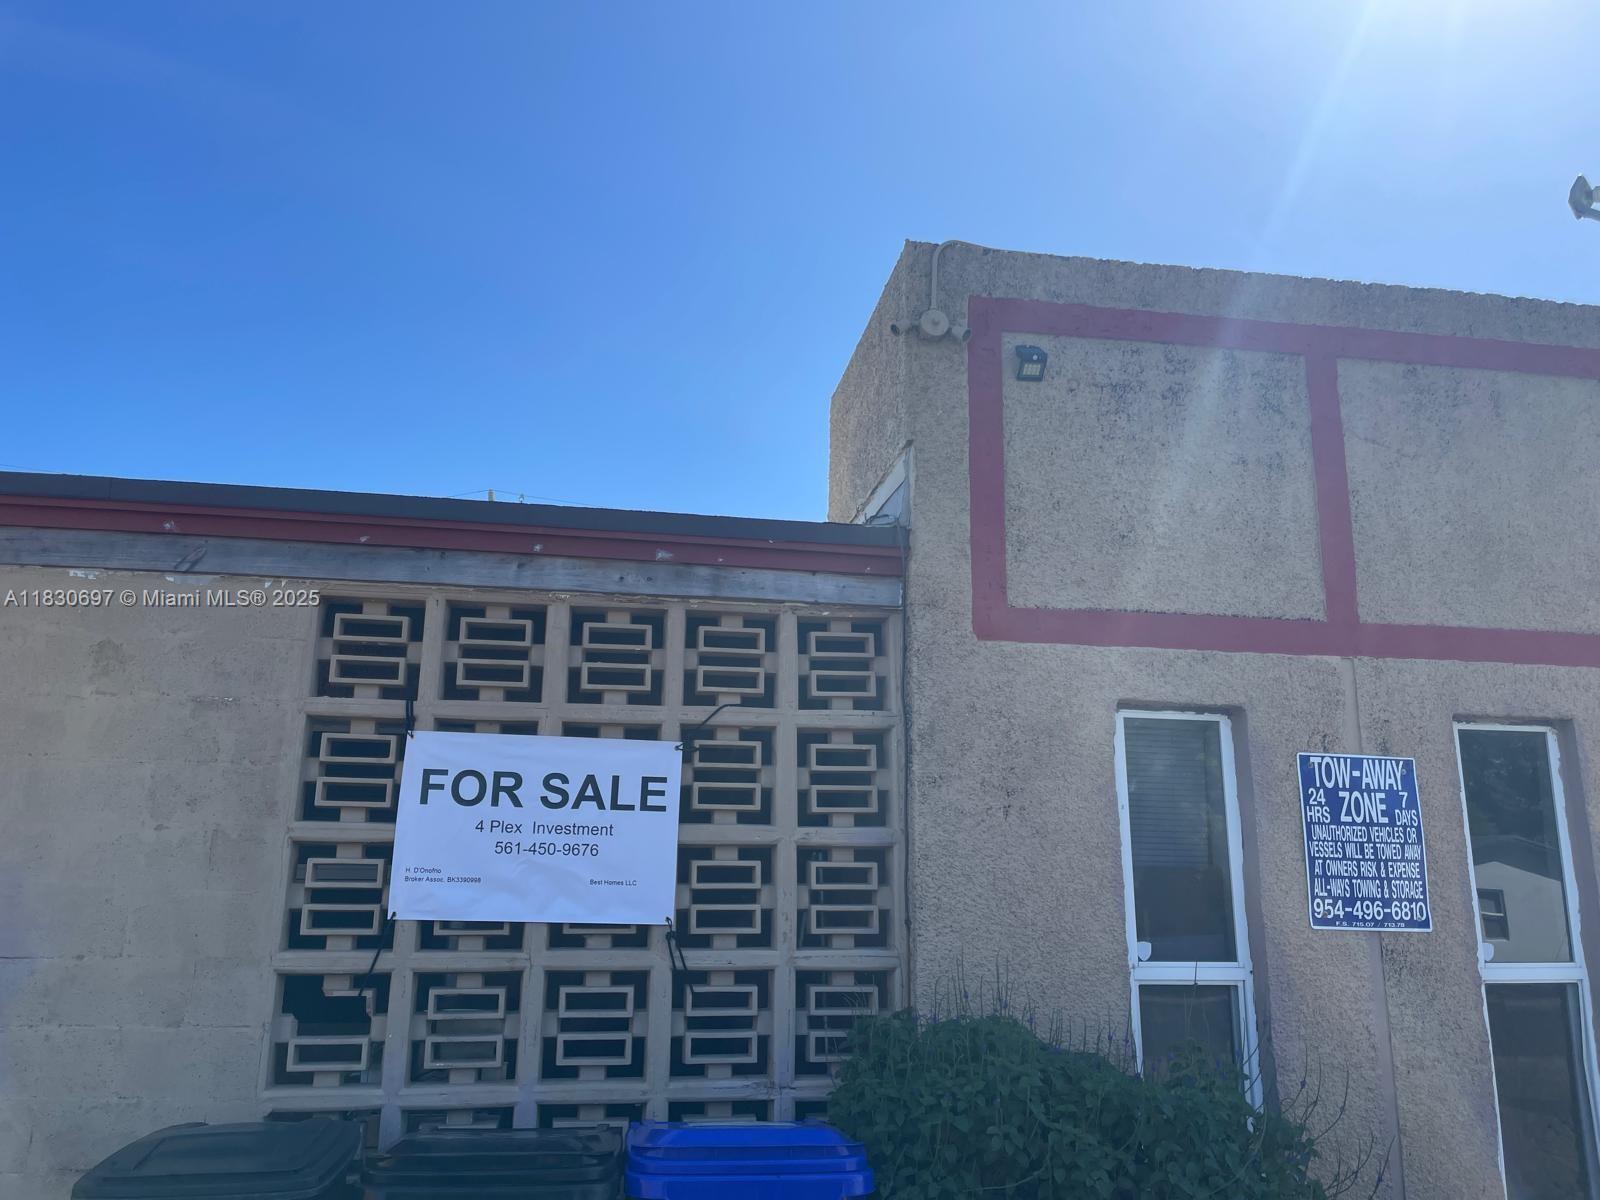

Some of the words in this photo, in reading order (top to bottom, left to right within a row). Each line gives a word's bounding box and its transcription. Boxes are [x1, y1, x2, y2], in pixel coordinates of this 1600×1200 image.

[1310, 757, 1403, 790] TOW-AWAY
[419, 768, 523, 808] FOR
[540, 772, 668, 812] SALE
[1308, 787, 1326, 805] 24
[1398, 791, 1408, 809] 7
[1306, 805, 1331, 823] HRS
[1338, 790, 1389, 824] ZONE
[1394, 808, 1419, 827] DAYS
[475, 820, 485, 833] 4
[489, 820, 523, 834] Plex
[532, 821, 614, 837] Investment
[1311, 824, 1368, 841] UNAUTHORIZED
[1368, 826, 1404, 843] VEHICLES
[1406, 827, 1418, 844] OR
[494, 841, 599, 857] 561-450-9676
[1308, 841, 1343, 858] VESSELS
[1344, 843, 1362, 859] WILL
[1364, 843, 1375, 860] BE
[1376, 844, 1402, 860] TOWED
[1404, 844, 1422, 861] AWAY
[1314, 859, 1323, 876] AT
[1325, 860, 1358, 877] OWNERS
[1360, 861, 1378, 877] RISK
[1380, 862, 1386, 878] &
[1388, 862, 1421, 879] EXPENSE
[589, 878, 603, 886] Best
[1314, 877, 1351, 898] ALL-WAYS
[1352, 879, 1381, 899] TOWING
[1383, 880, 1390, 899] &
[1391, 880, 1424, 900] STORAGE
[1313, 898, 1427, 921] 954-496-6810
